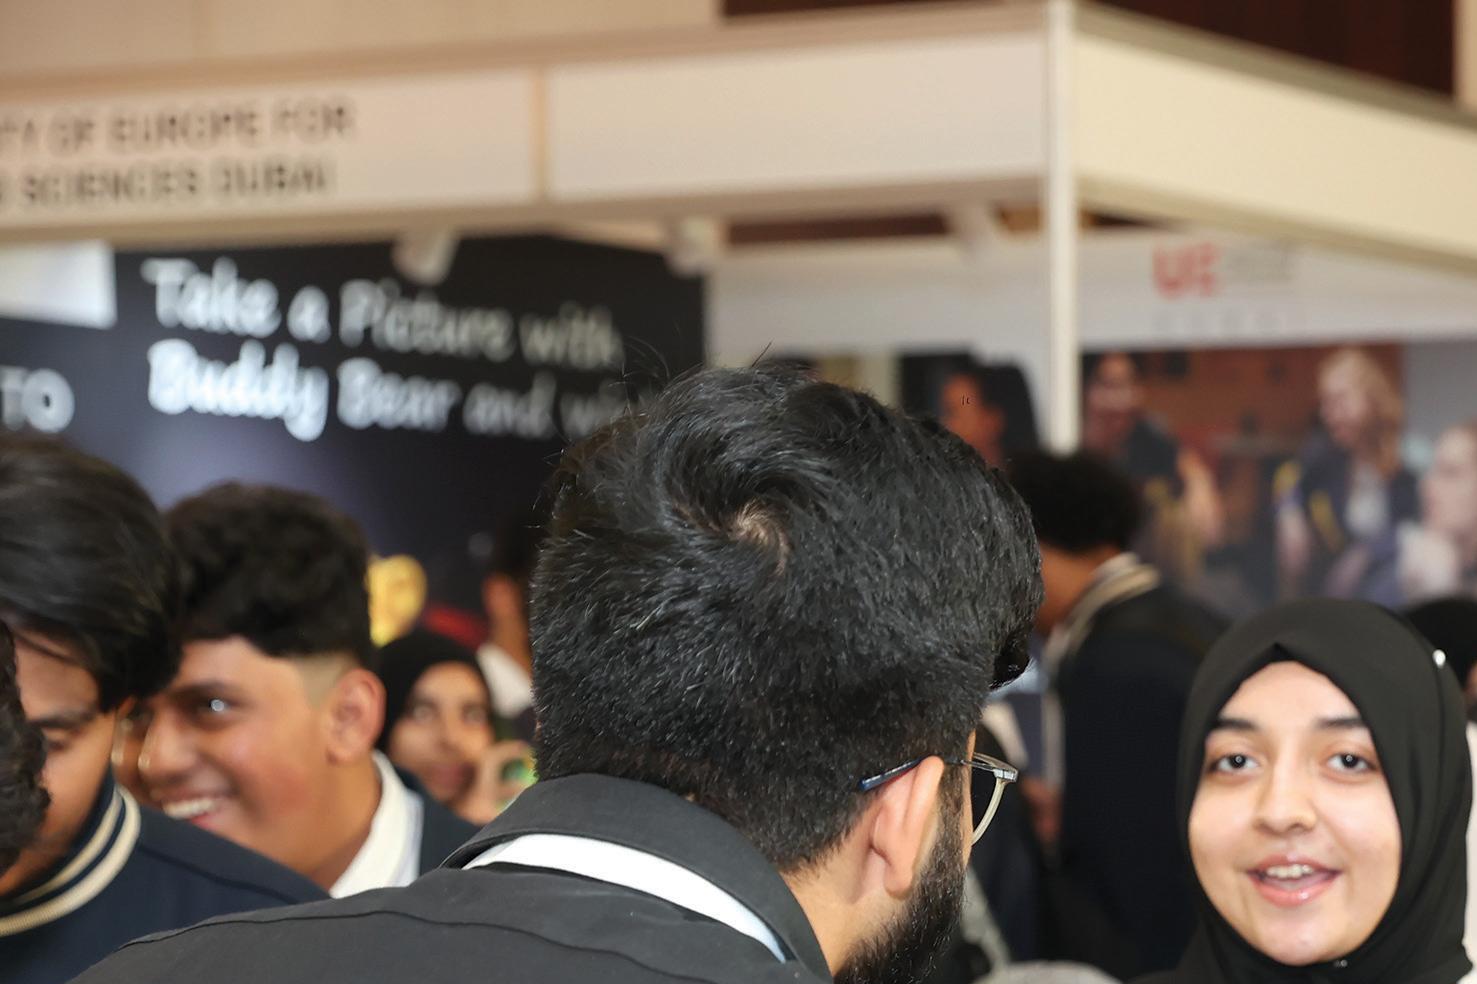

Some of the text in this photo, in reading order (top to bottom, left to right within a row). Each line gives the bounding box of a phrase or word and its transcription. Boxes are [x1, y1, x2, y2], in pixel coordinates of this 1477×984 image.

[140, 257, 281, 338] Take
[287, 285, 331, 343] a
[337, 278, 515, 362] Picture
[148, 338, 329, 441] Buddy
[336, 356, 462, 430] Bear
[463, 371, 556, 438] and
